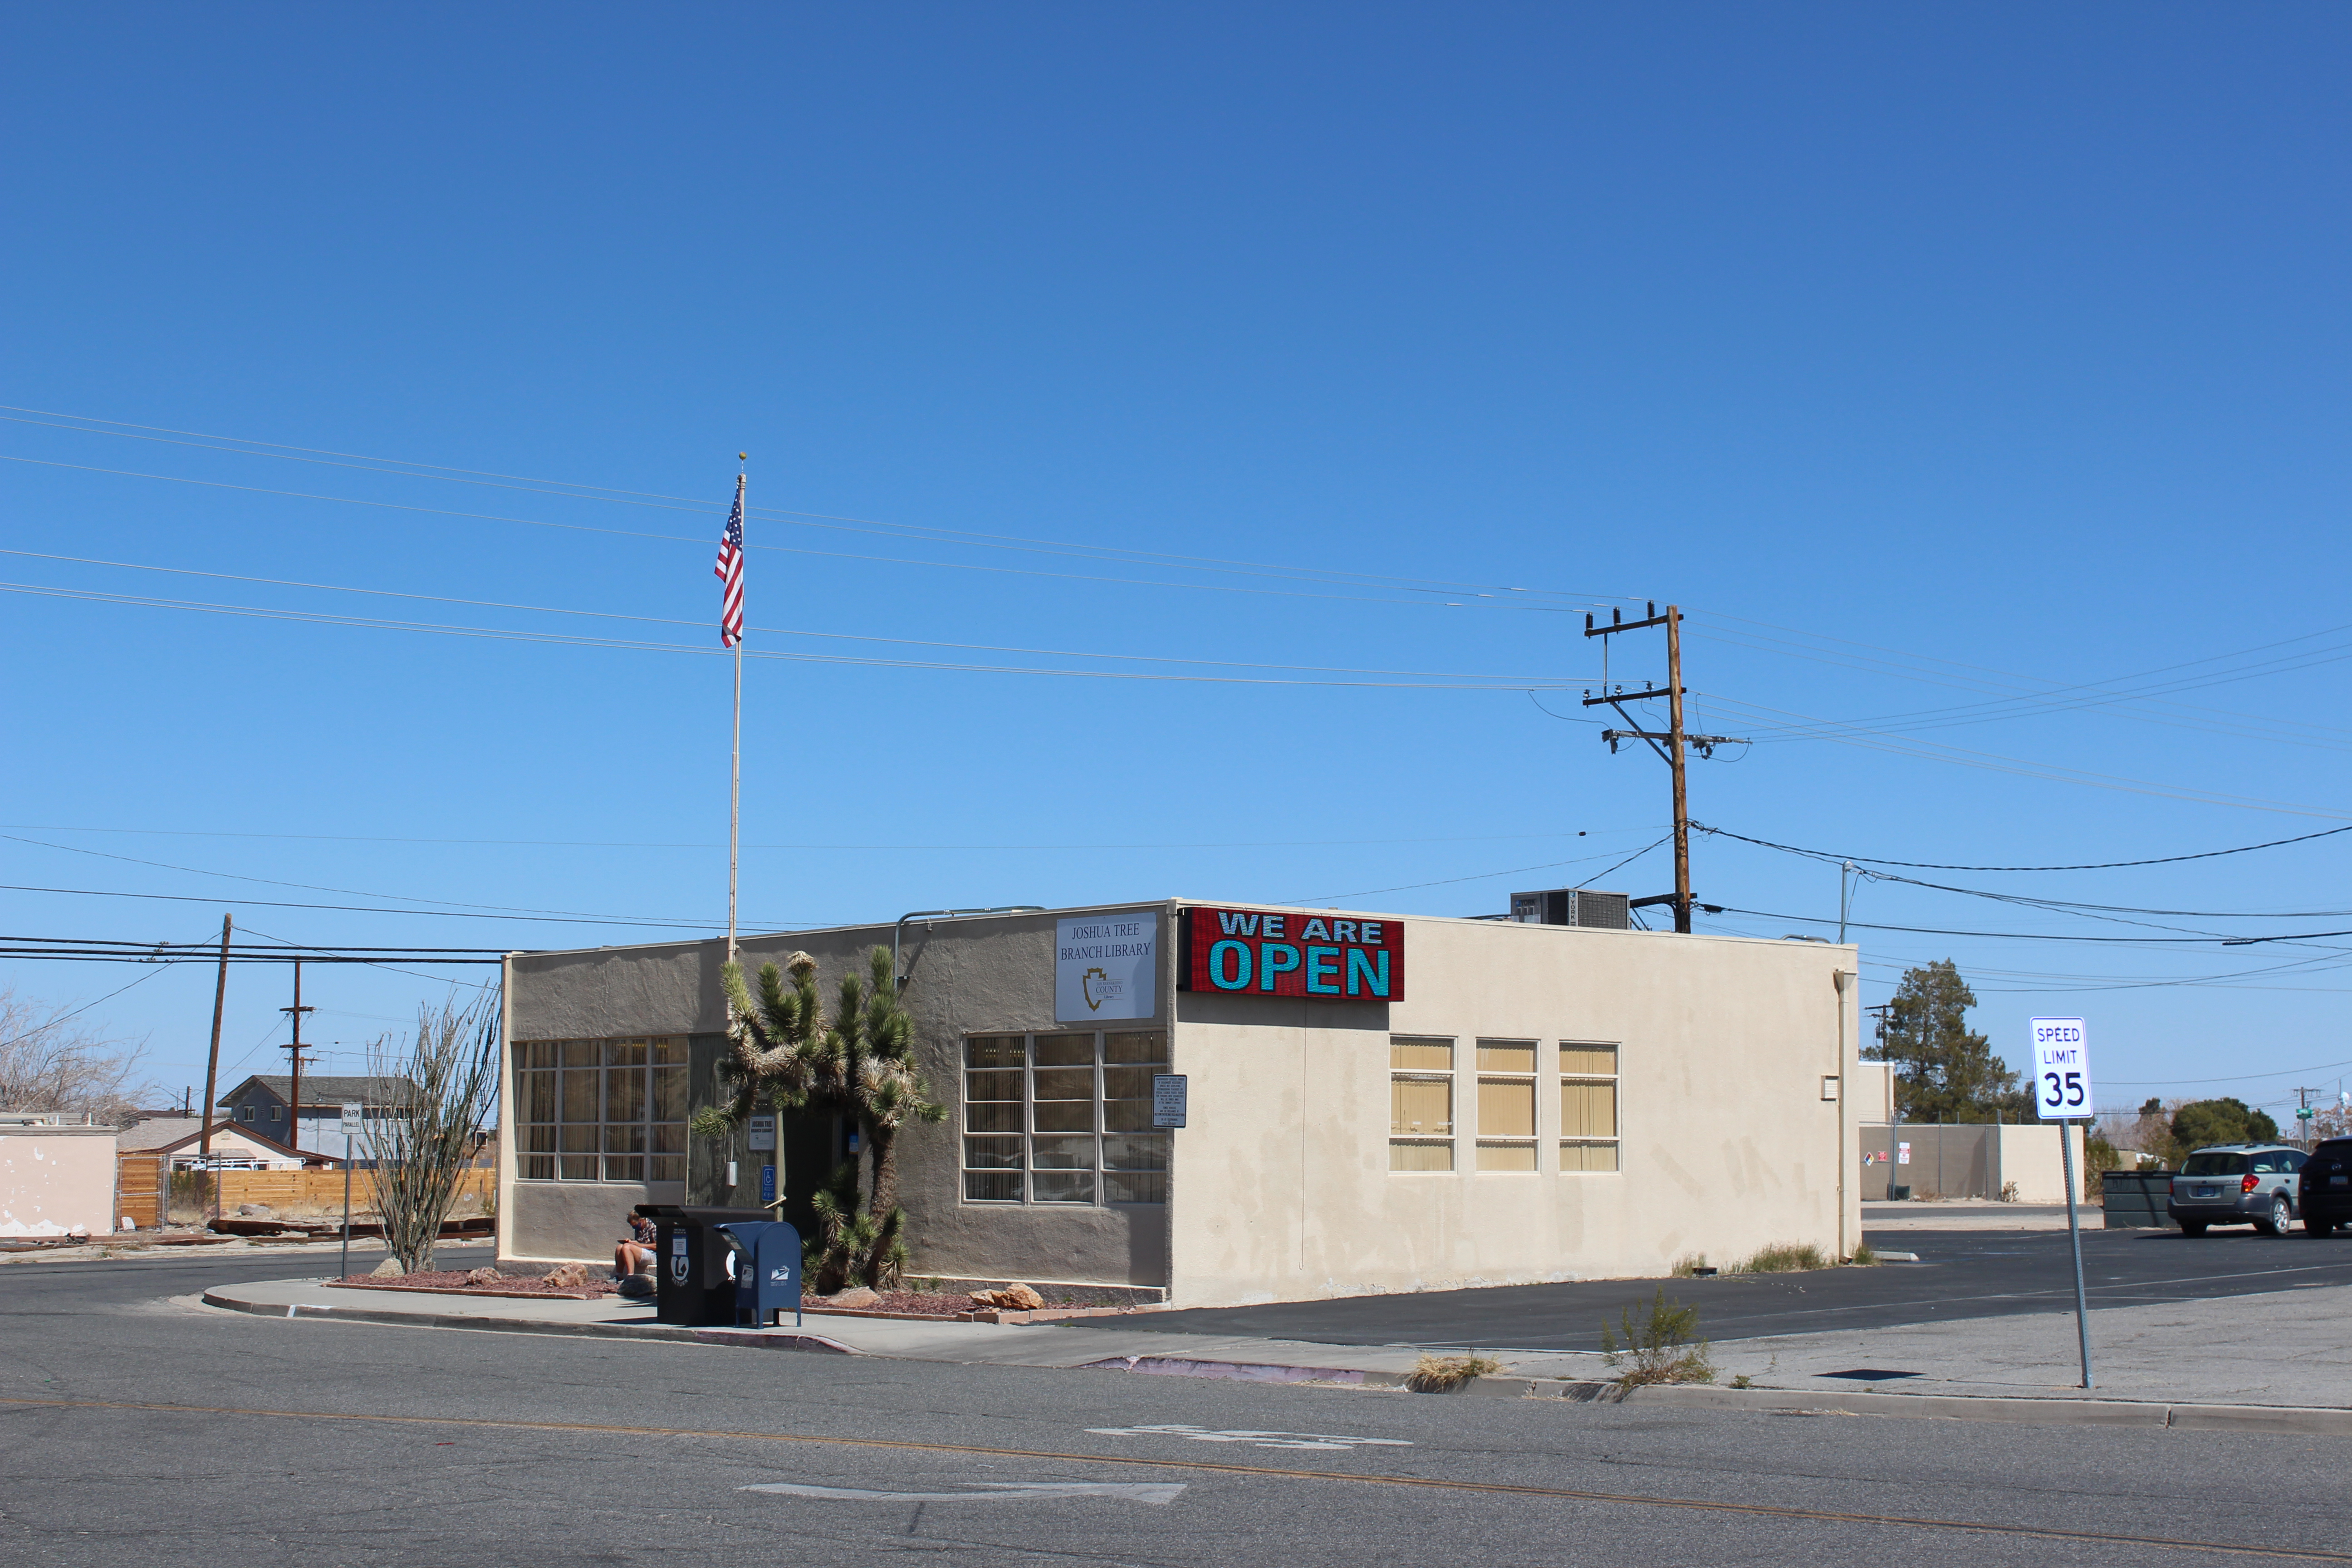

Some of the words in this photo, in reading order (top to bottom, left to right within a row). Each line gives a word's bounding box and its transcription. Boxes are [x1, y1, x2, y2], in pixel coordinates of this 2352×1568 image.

[1072, 926, 1111, 940] JOSHUA
[1114, 923, 1140, 936] TREE
[1218, 912, 1284, 938] WE
[1301, 919, 1382, 944] ARE
[1061, 946, 1102, 960] BRANCH
[1105, 942, 1151, 957] LIBRARY
[1210, 939, 1389, 996] OPEN
[1096, 985, 1122, 994] COUNTY
[2037, 1027, 2080, 1042] SPEED
[2043, 1050, 2077, 1063] LIMIT
[2044, 1072, 2084, 1107] 35
[671, 1277, 688, 1287] RETURN
